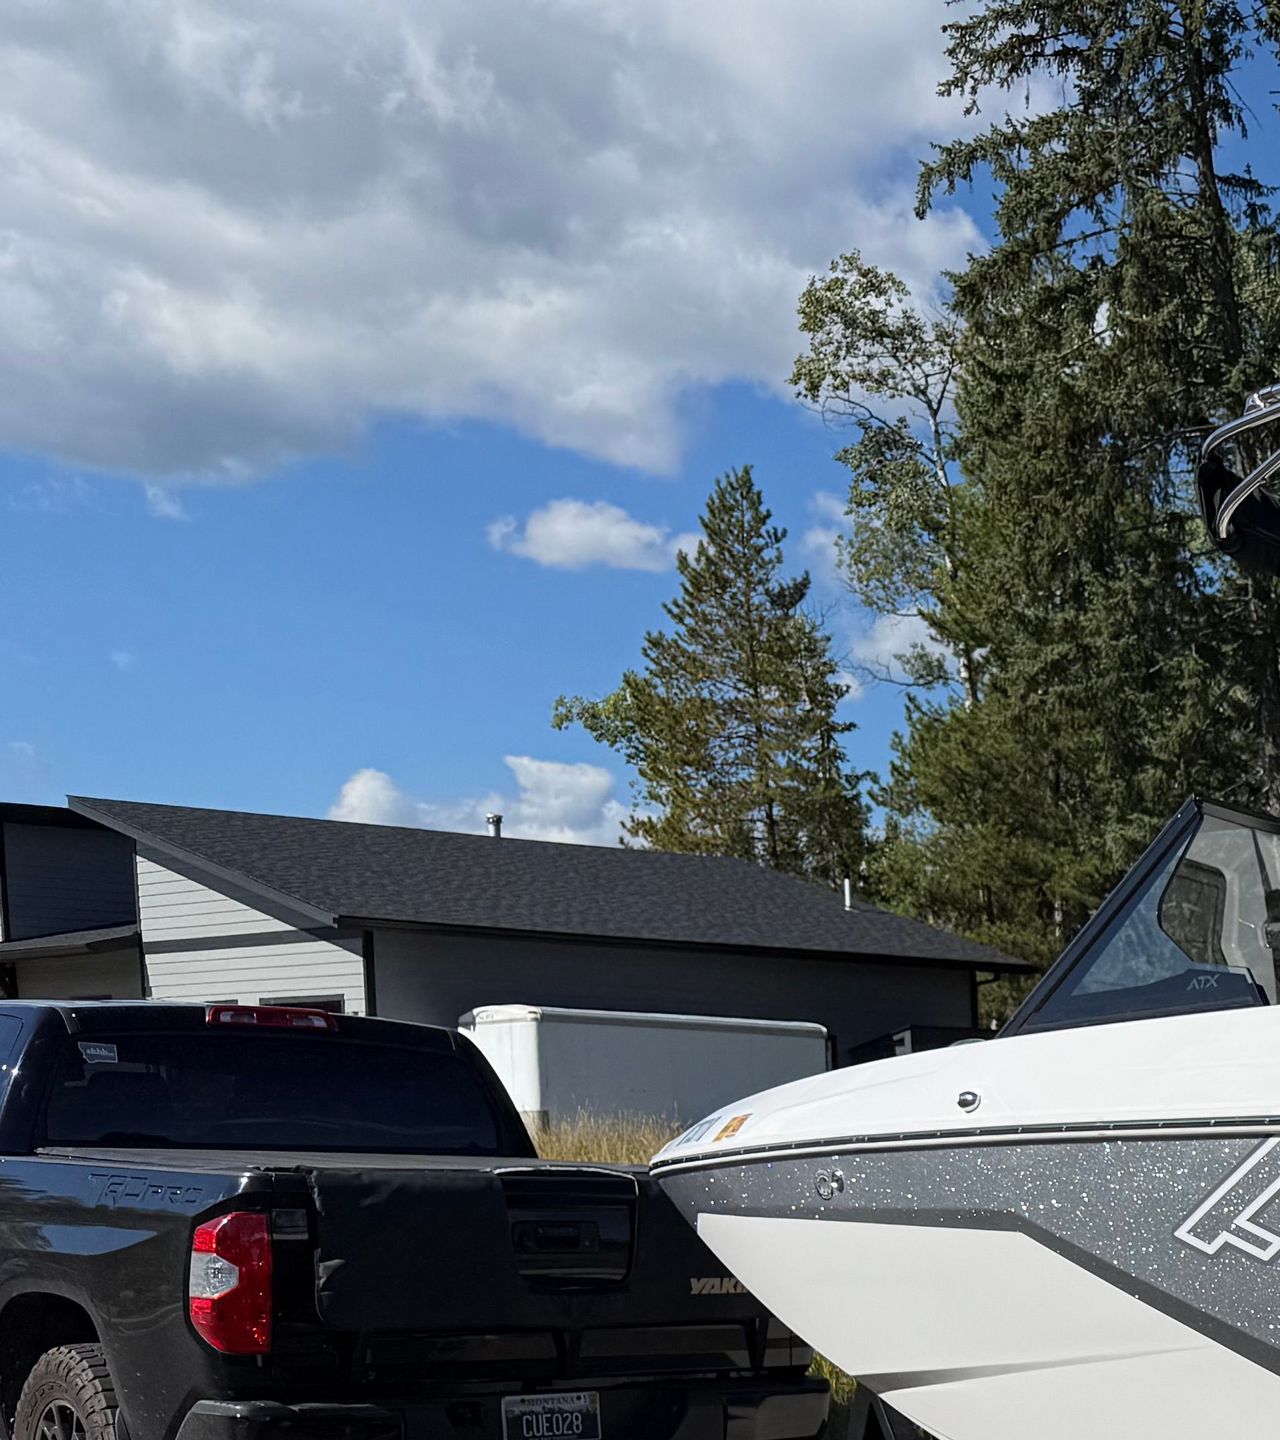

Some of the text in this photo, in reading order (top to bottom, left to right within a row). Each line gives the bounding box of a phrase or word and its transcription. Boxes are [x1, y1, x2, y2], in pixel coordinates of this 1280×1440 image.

[1186, 974, 1221, 991] ATX
[526, 1395, 577, 1407] MONTANA
[522, 1411, 583, 1438] CUE028
